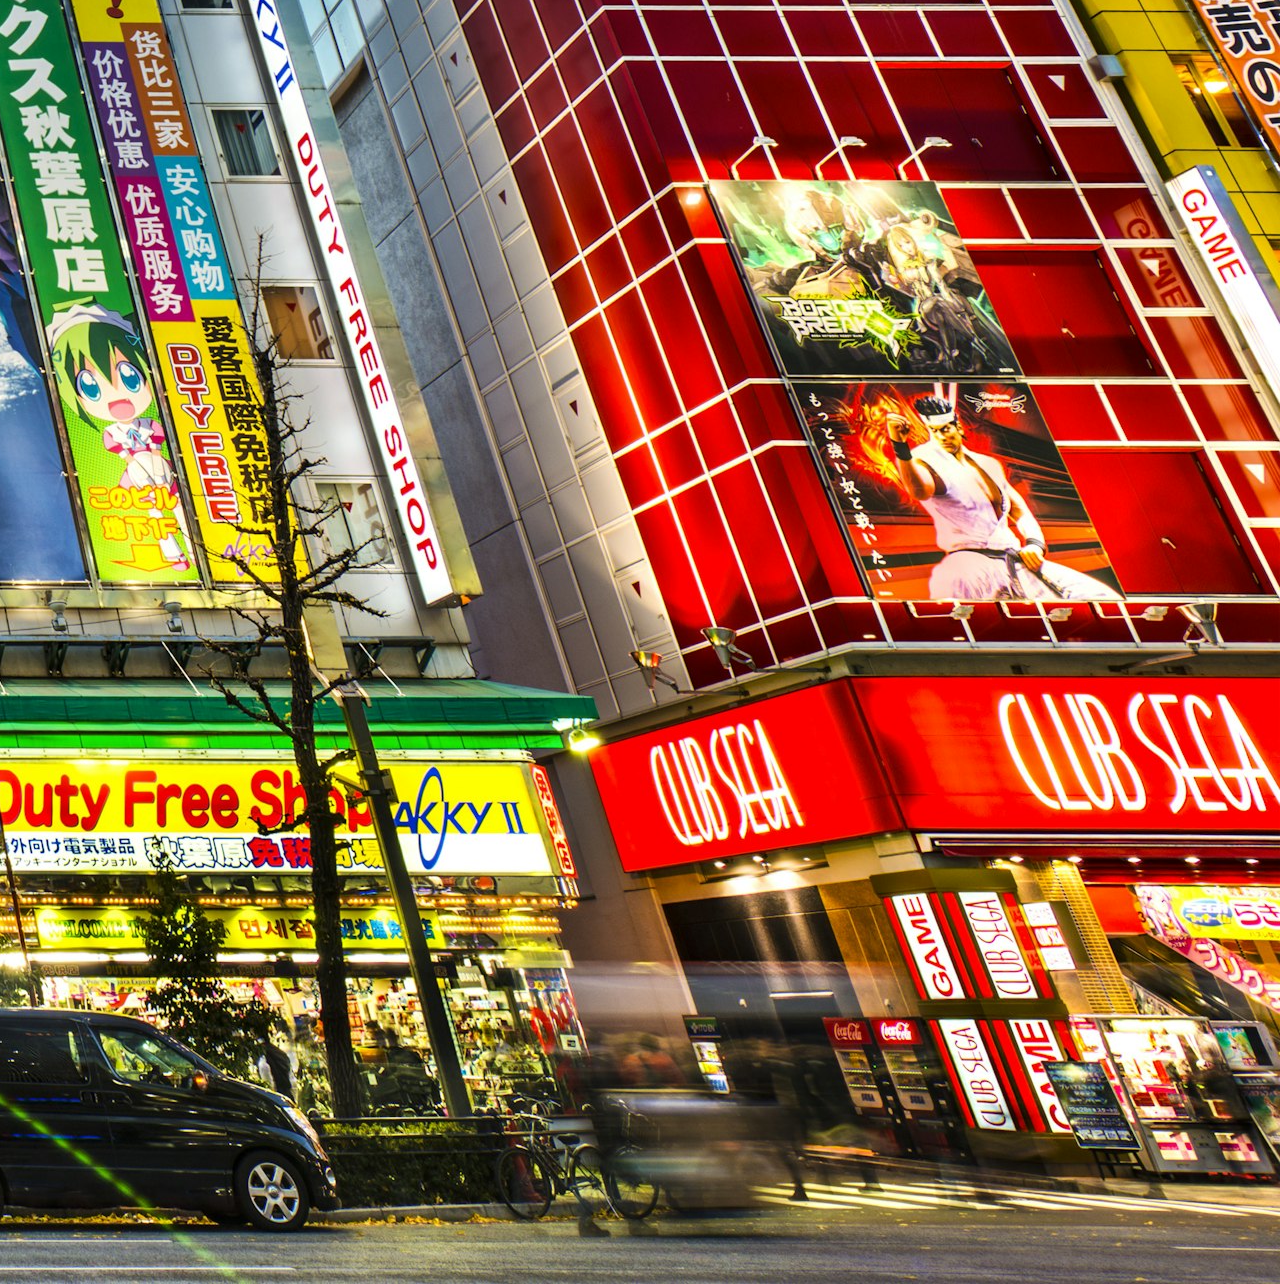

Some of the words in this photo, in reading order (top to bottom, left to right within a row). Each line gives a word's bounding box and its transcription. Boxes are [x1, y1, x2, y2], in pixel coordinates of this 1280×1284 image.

[92, 49, 149, 171] 价格优惠
[130, 29, 189, 150] 货比三家
[125, 184, 184, 316] 优质服务
[166, 164, 225, 293] 安心购物
[1182, 188, 1247, 285] GAME
[766, 297, 885, 316] BORDER
[781, 316, 872, 339] BREAK
[298, 133, 344, 254] DUTY
[340, 281, 389, 408] FREE
[384, 425, 439, 571] SHOP
[166, 343, 210, 429] DUTY
[190, 432, 241, 524] FREE
[89, 487, 178, 512] このビル
[101, 515, 178, 542] 地下1F
[650, 734, 719, 846] CLUB
[710, 719, 804, 840] SEGA
[999, 693, 1148, 811] CLUB
[1136, 693, 1280, 814] SEGA
[124, 770, 239, 829] Free
[44, 919, 124, 939] WELCOME
[239, 919, 314, 940] 면세점
[902, 896, 955, 998] GAME
[965, 899, 1016, 945] SEGA
[983, 945, 1033, 996] CLUB
[951, 1026, 992, 1077] SEGA
[968, 1078, 1008, 1127] CLUB
